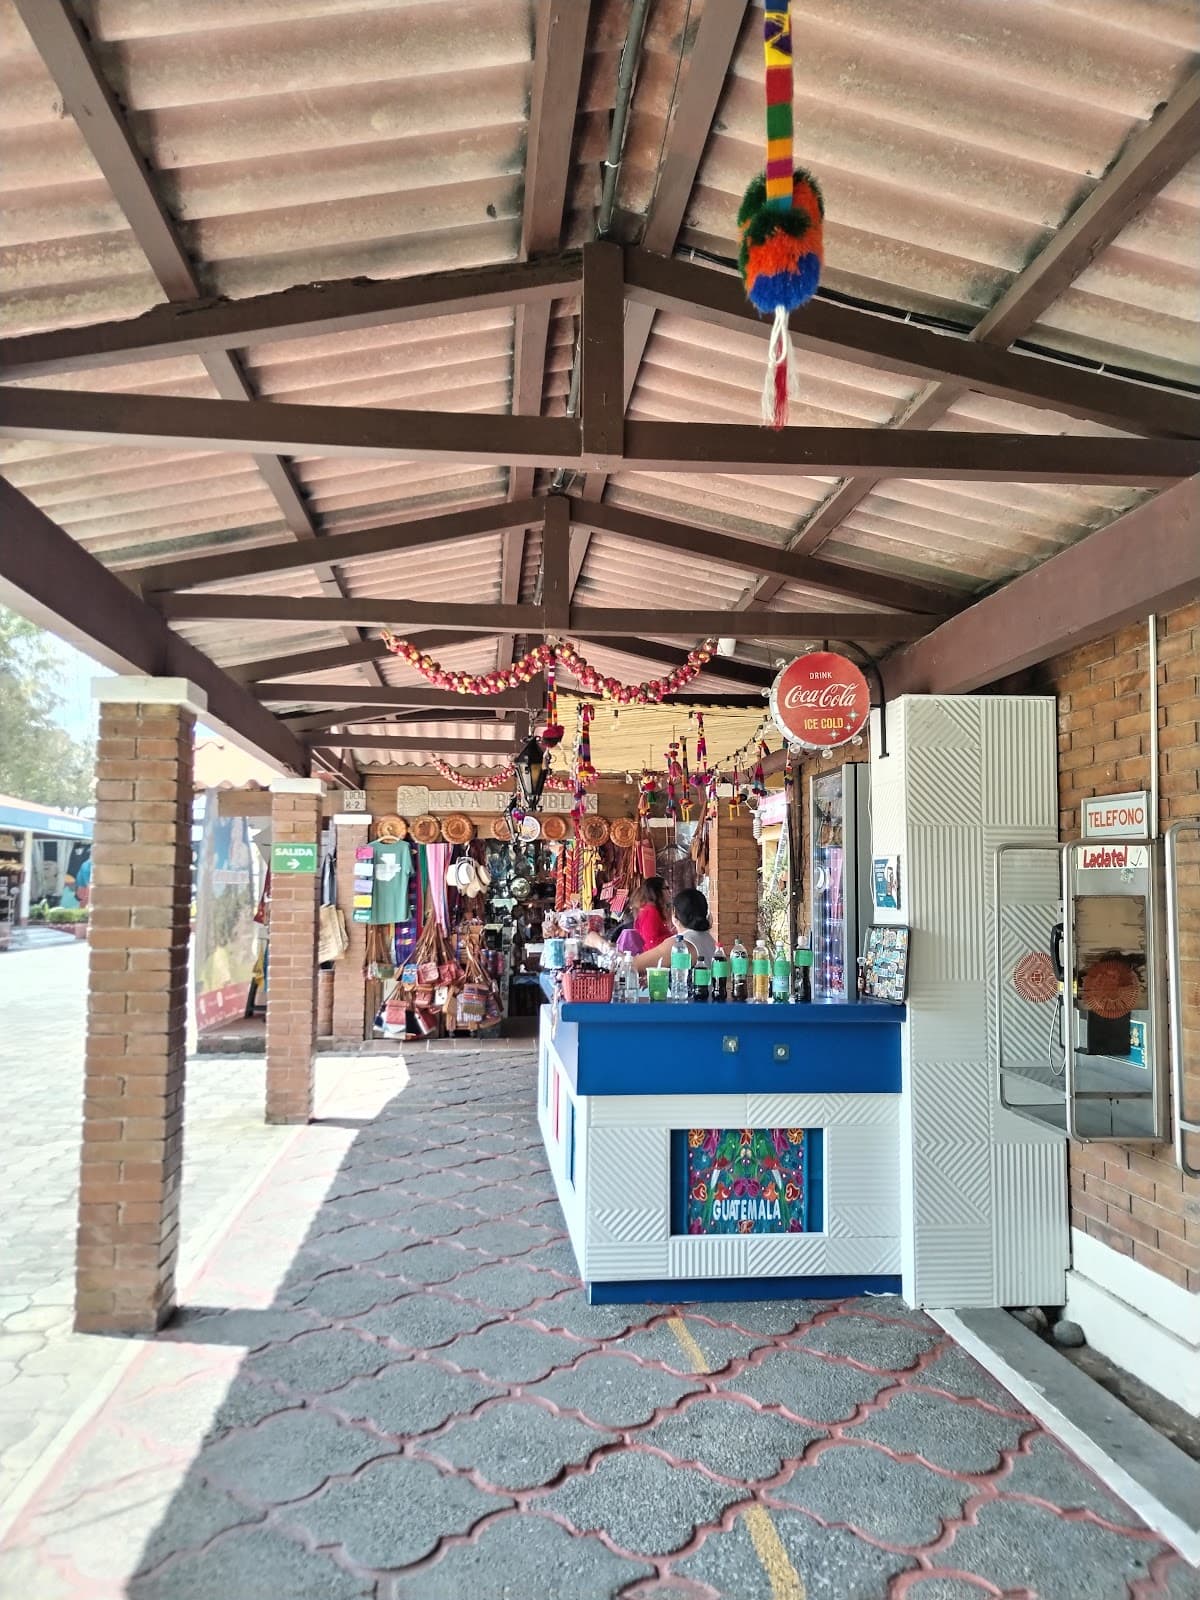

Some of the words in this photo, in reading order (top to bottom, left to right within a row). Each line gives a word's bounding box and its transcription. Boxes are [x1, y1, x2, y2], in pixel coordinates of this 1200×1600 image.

[809, 671, 832, 680] DRINK
[784, 683, 860, 709] Coca-Cola
[804, 718, 819, 730] ICE
[821, 717, 844, 729] COLD
[429, 792, 481, 808] MAYA
[1088, 807, 1144, 828] TELEFONO
[275, 847, 314, 857] SALIDA
[1083, 843, 1128, 868] Ladatel
[712, 1199, 781, 1221] GUATEMALA
